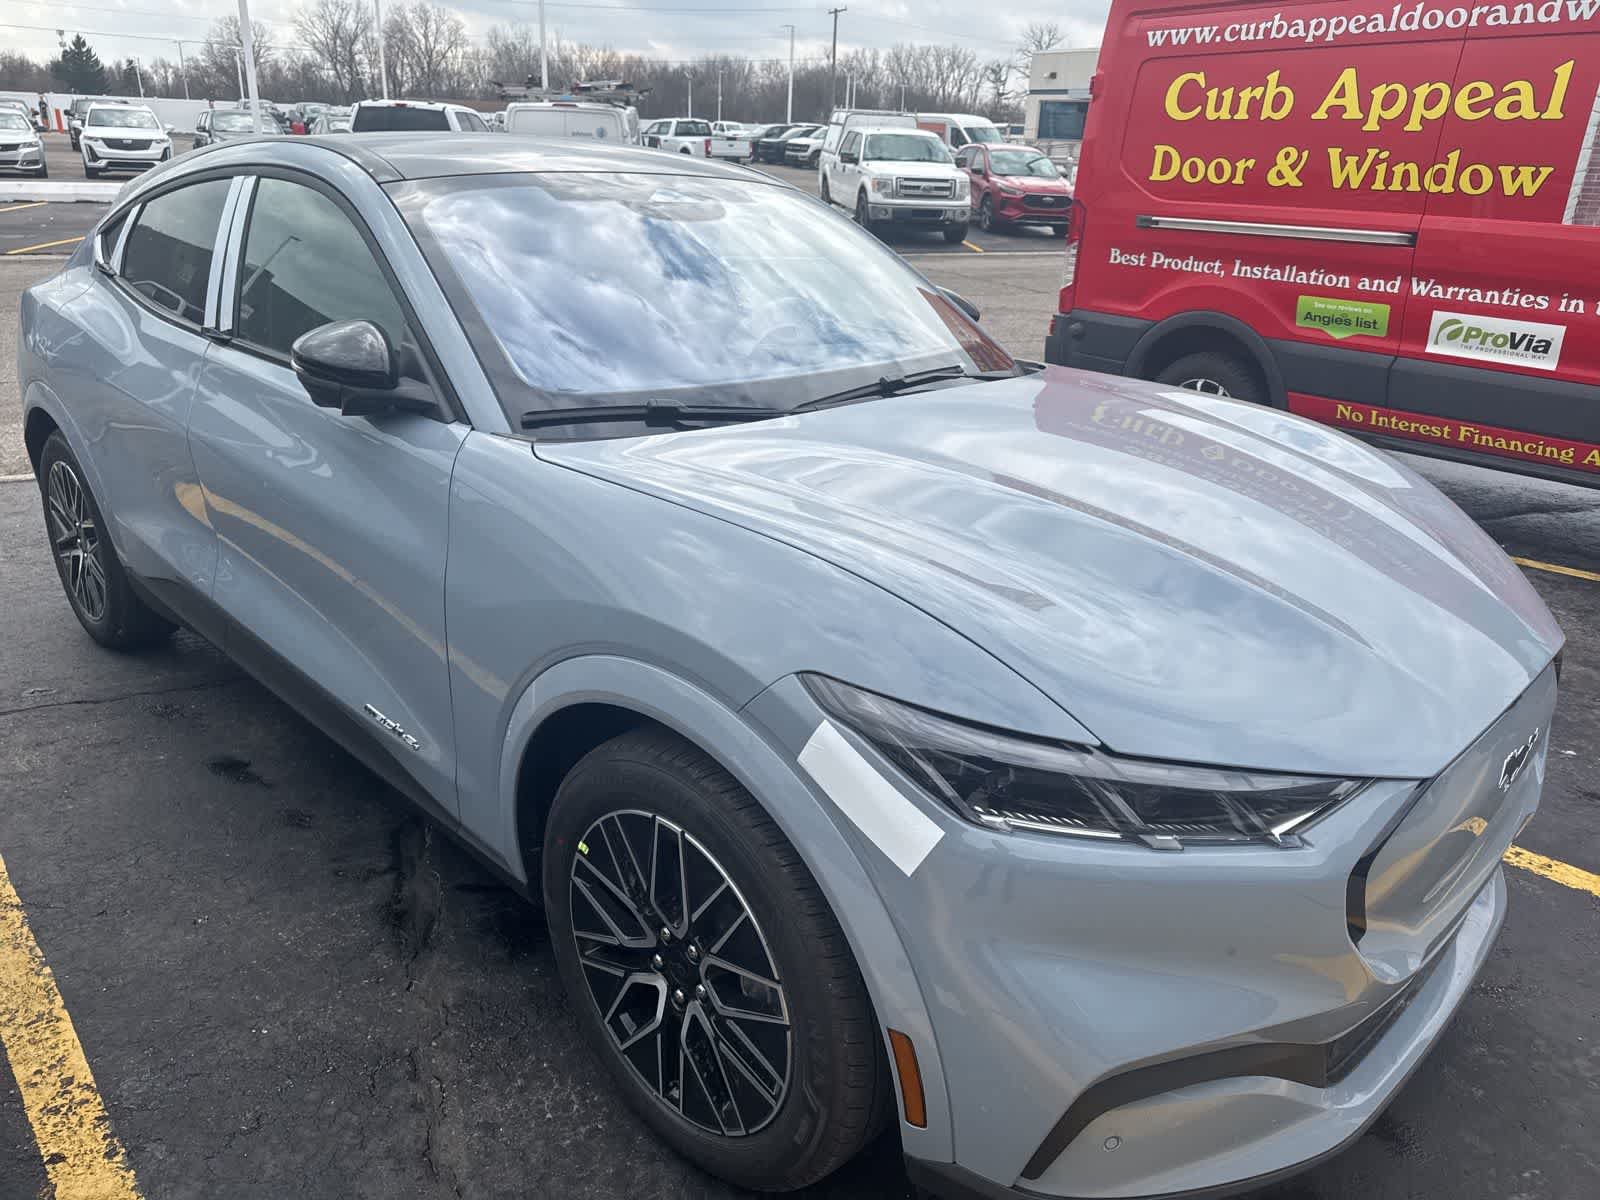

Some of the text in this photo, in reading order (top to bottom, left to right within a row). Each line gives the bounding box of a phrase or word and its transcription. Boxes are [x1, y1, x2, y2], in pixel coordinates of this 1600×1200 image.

[1165, 59, 1575, 132] Curb Appeal
[1149, 144, 1554, 197] Door & Window
[1109, 248, 1147, 267] Best
[1150, 252, 1225, 278] Product,
[1231, 259, 1350, 289] Installation
[1357, 276, 1401, 294] and
[1410, 277, 1550, 310] Warranties
[1558, 292, 1585, 314] in
[1355, 316, 1377, 329] list
[1462, 326, 1553, 355] ProVia
[1460, 343, 1472, 351] THE
[1475, 345, 1529, 359] PROFESSIONAL
[1336, 404, 1364, 422] No
[1370, 410, 1451, 439] Interest
[1458, 426, 1576, 464] Financing
